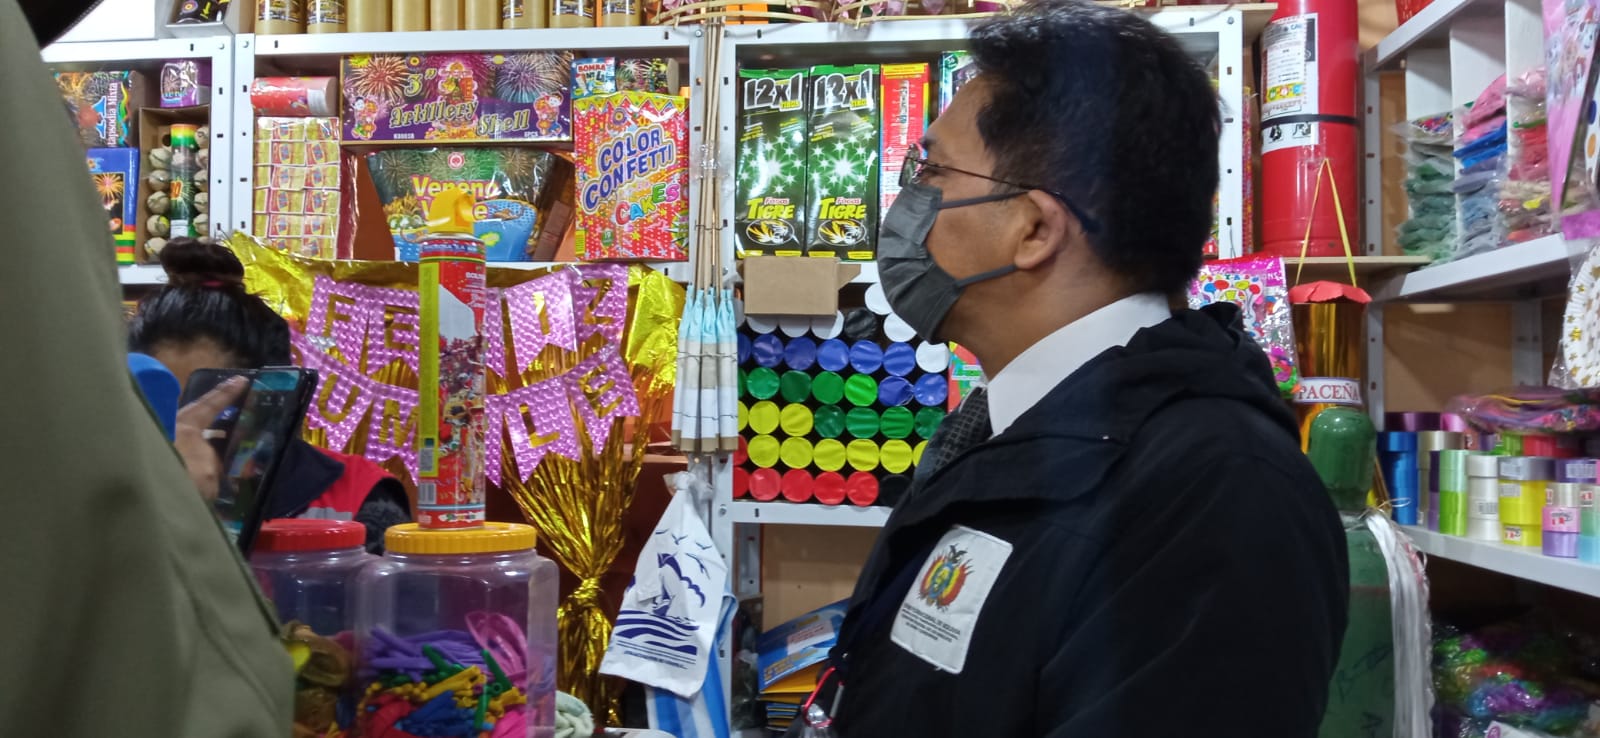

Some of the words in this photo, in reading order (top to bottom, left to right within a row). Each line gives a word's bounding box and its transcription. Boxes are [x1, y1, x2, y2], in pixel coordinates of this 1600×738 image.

[578, 64, 606, 72] BOMBA
[107, 82, 118, 105] Mixta
[744, 73, 803, 112] 12x1
[389, 100, 479, 128] Artillery
[476, 109, 531, 136] Shell
[600, 128, 661, 172] COLOR
[585, 145, 673, 210] CONFETTI
[615, 183, 681, 226] CAKES
[1298, 382, 1359, 401] PACEÑA
